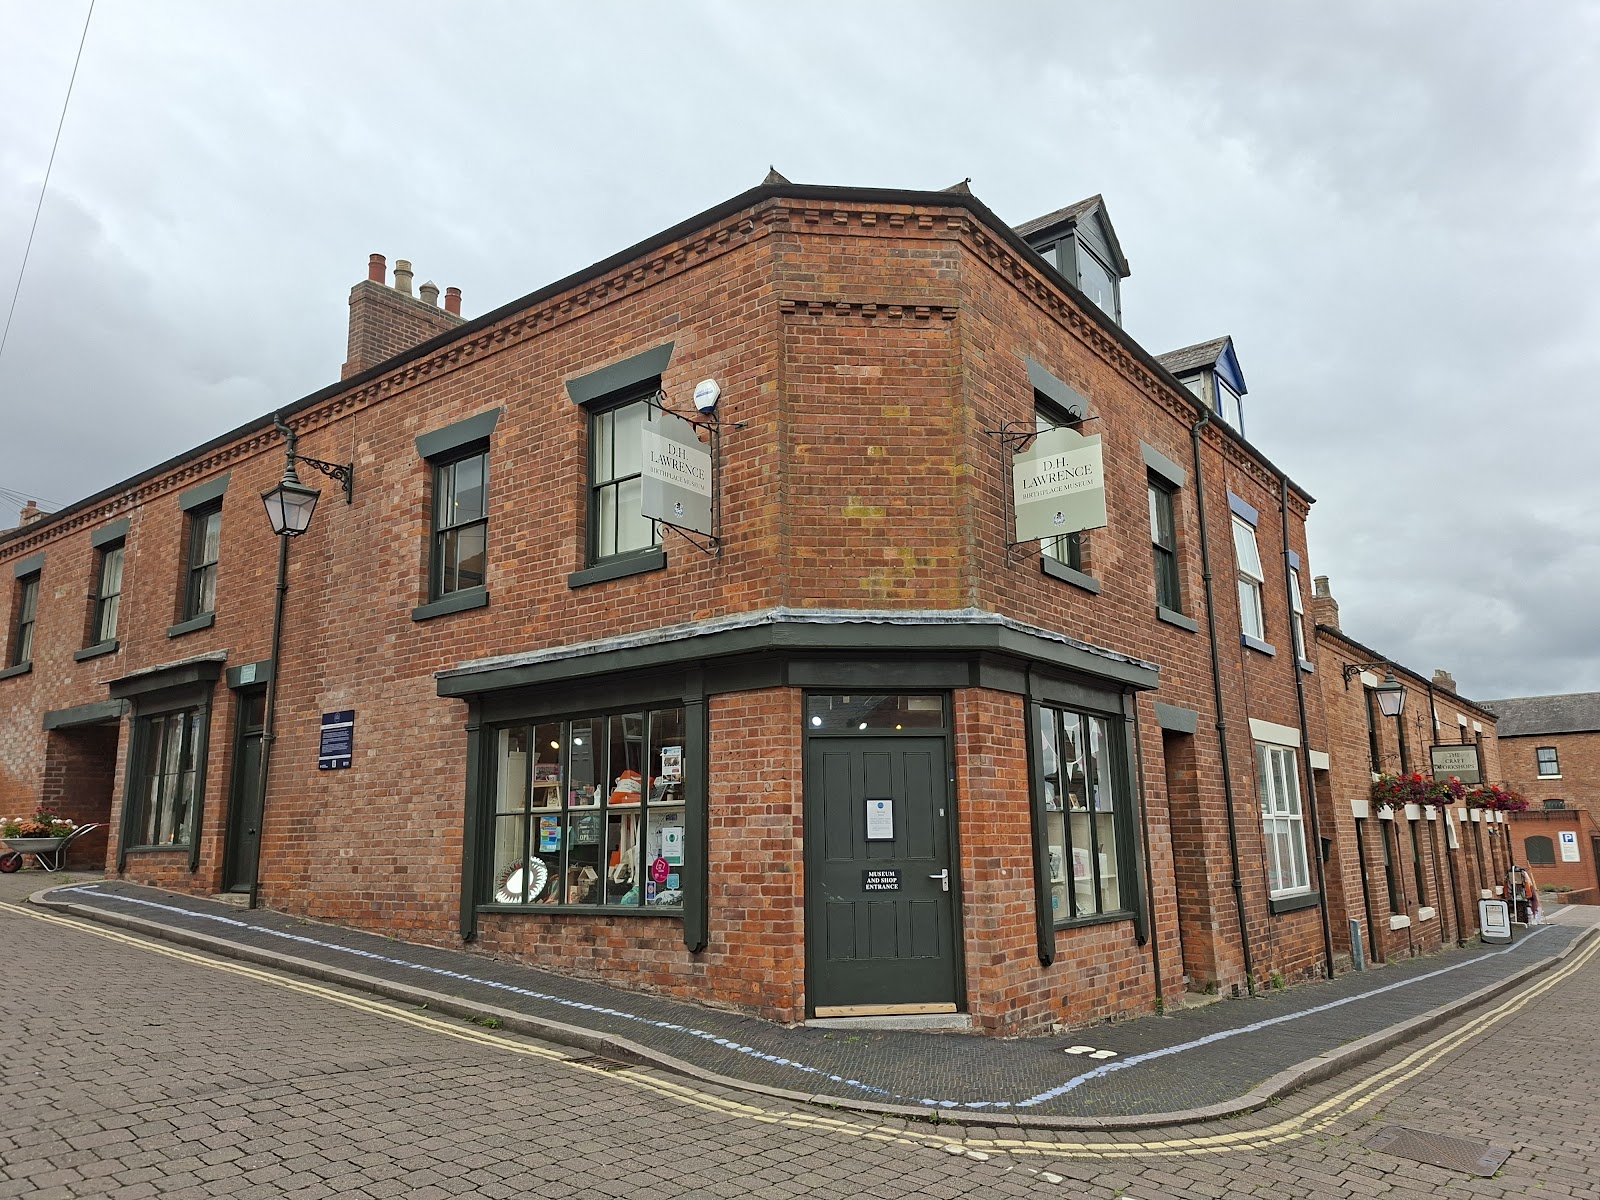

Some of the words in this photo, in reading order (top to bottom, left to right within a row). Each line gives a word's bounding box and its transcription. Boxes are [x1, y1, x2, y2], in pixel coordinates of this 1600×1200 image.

[668, 443, 689, 461] D.H.
[650, 450, 705, 481] LAWRENCE
[1043, 457, 1069, 471] D.H.
[1022, 464, 1093, 490] LAWRENCE
[1022, 485, 1063, 500] BIRTHPLACE
[1063, 479, 1094, 491] MUSEUM
